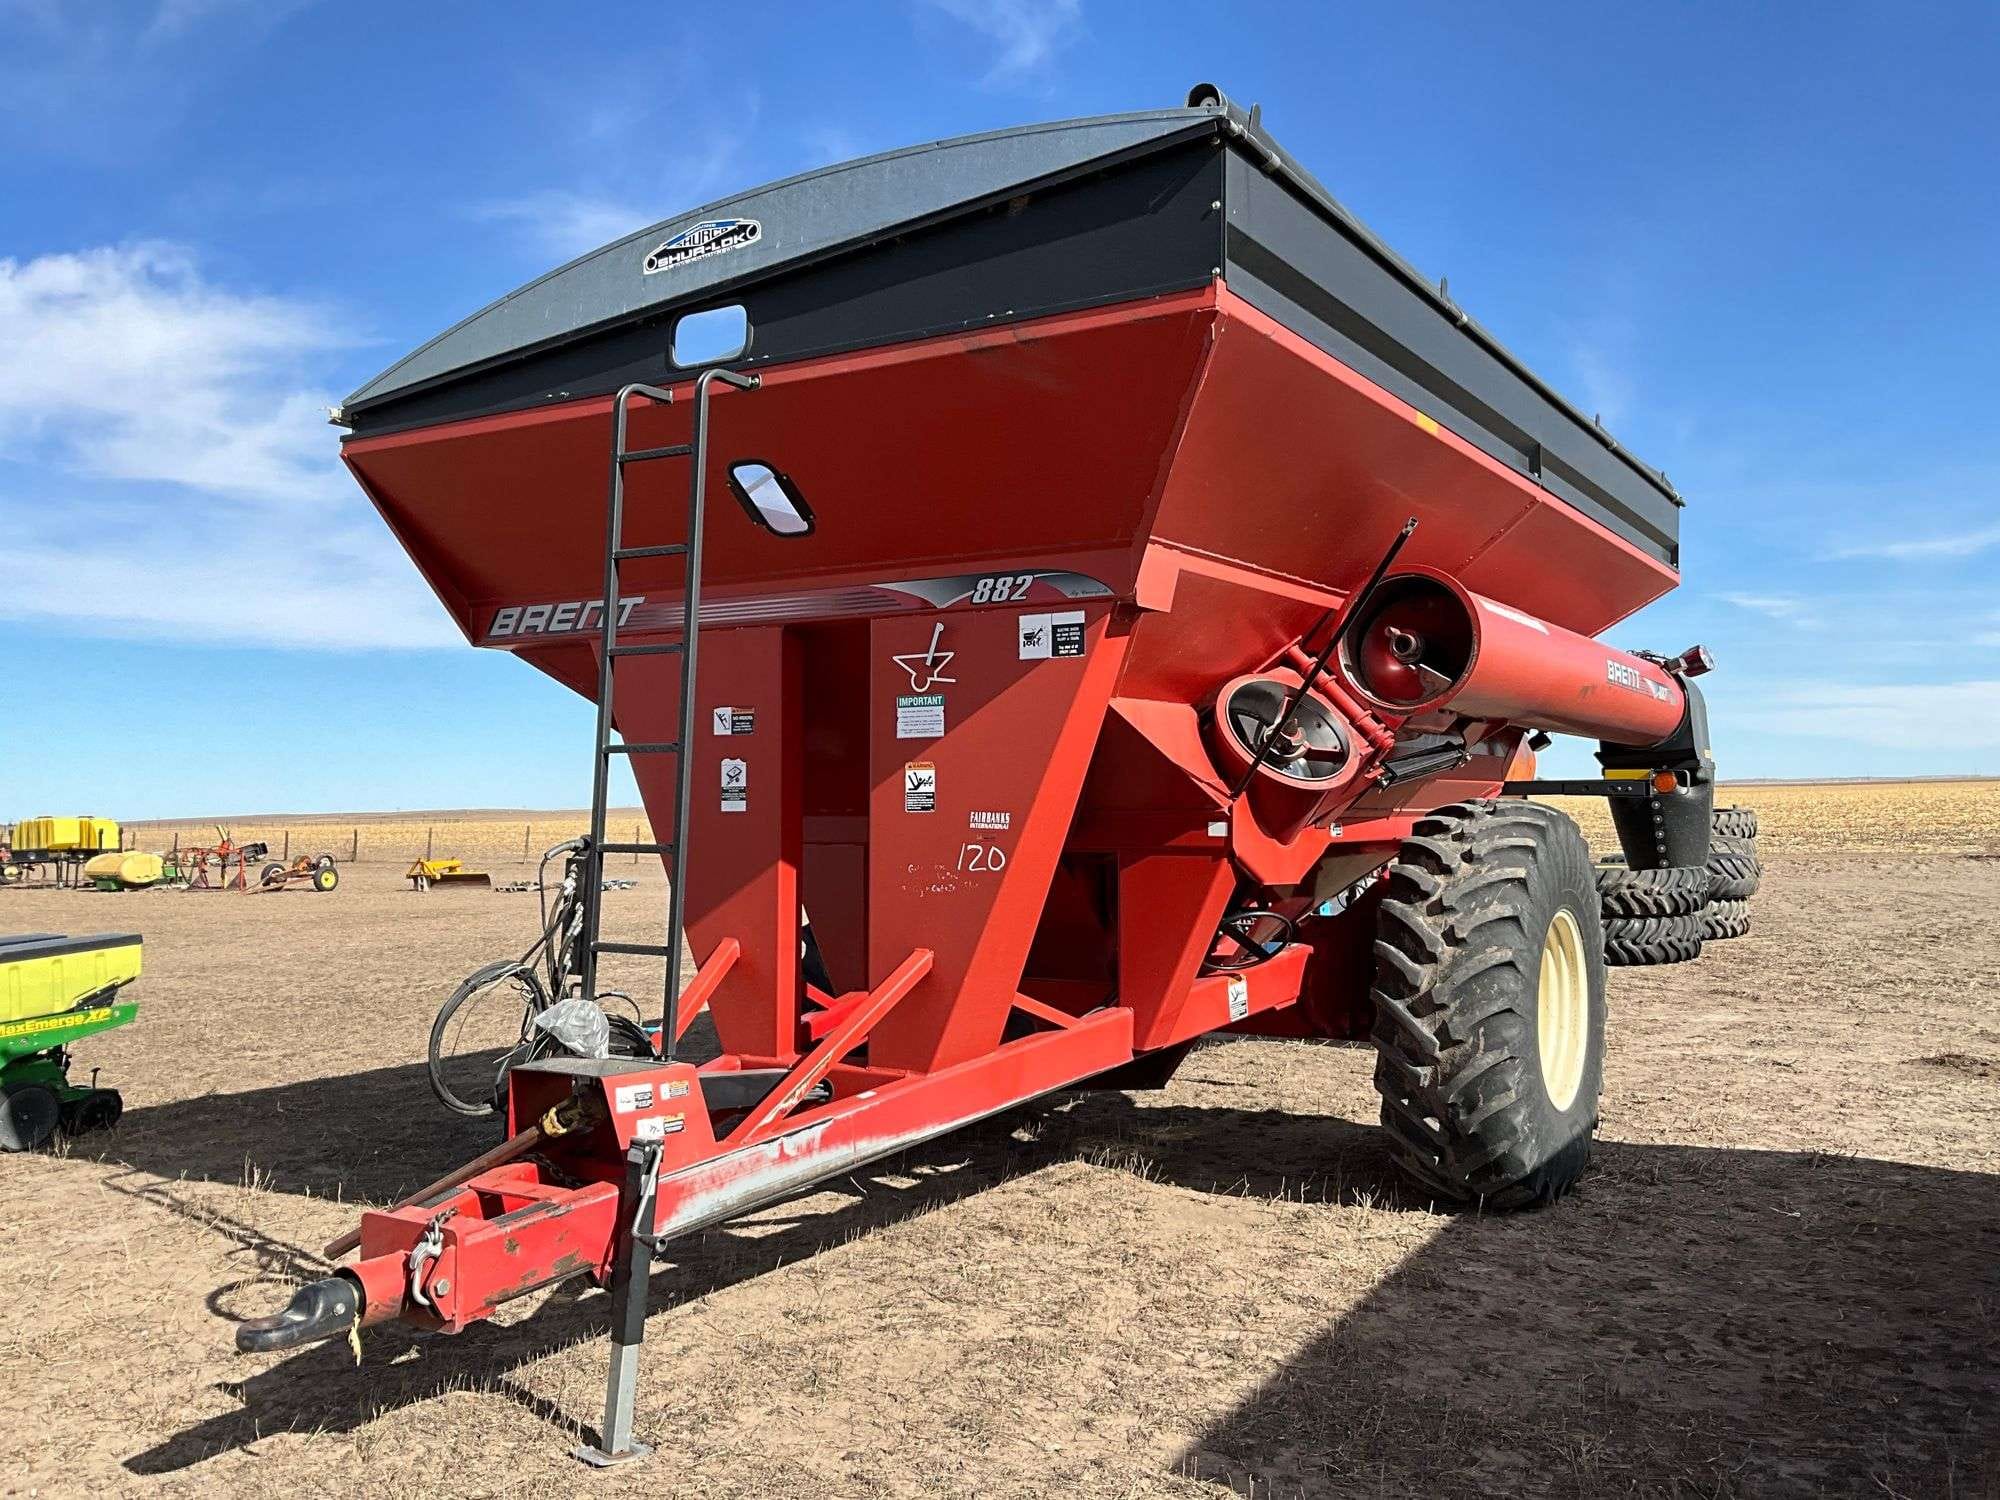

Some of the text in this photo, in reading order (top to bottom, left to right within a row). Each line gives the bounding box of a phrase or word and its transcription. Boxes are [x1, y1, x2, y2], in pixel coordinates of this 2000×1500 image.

[972, 575, 1035, 604] 882
[490, 596, 646, 636] BRENT
[899, 695, 943, 707] IMPORTANT
[970, 811, 1010, 824] FAIRBANKS
[957, 842, 1006, 872] 120
